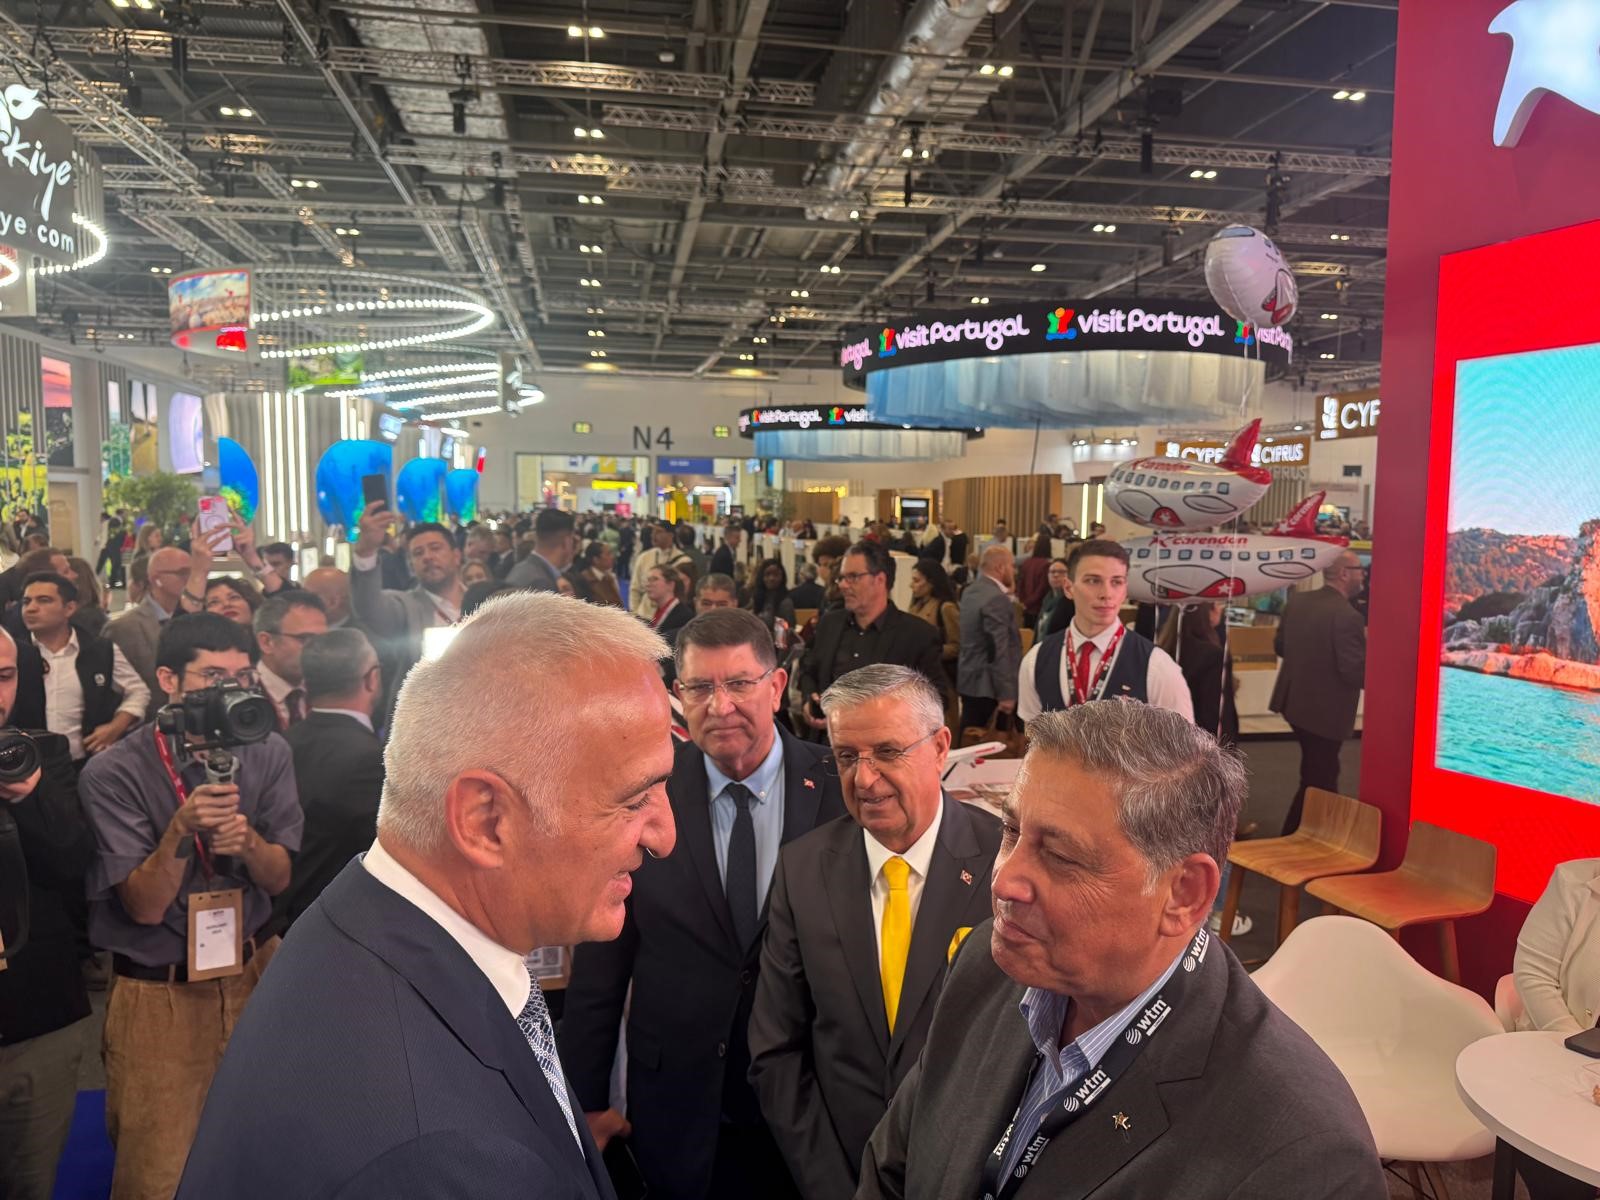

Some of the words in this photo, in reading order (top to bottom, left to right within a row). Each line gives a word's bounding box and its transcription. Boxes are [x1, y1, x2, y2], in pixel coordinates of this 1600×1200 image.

[37, 224, 74, 254] com
[633, 426, 675, 451] N4
[1260, 443, 1304, 464] CYPRUS
[1190, 927, 1207, 957] wtm
[1136, 999, 1168, 1031] wtm
[1075, 1069, 1107, 1100] wtm
[1022, 1136, 1047, 1163] wtm
